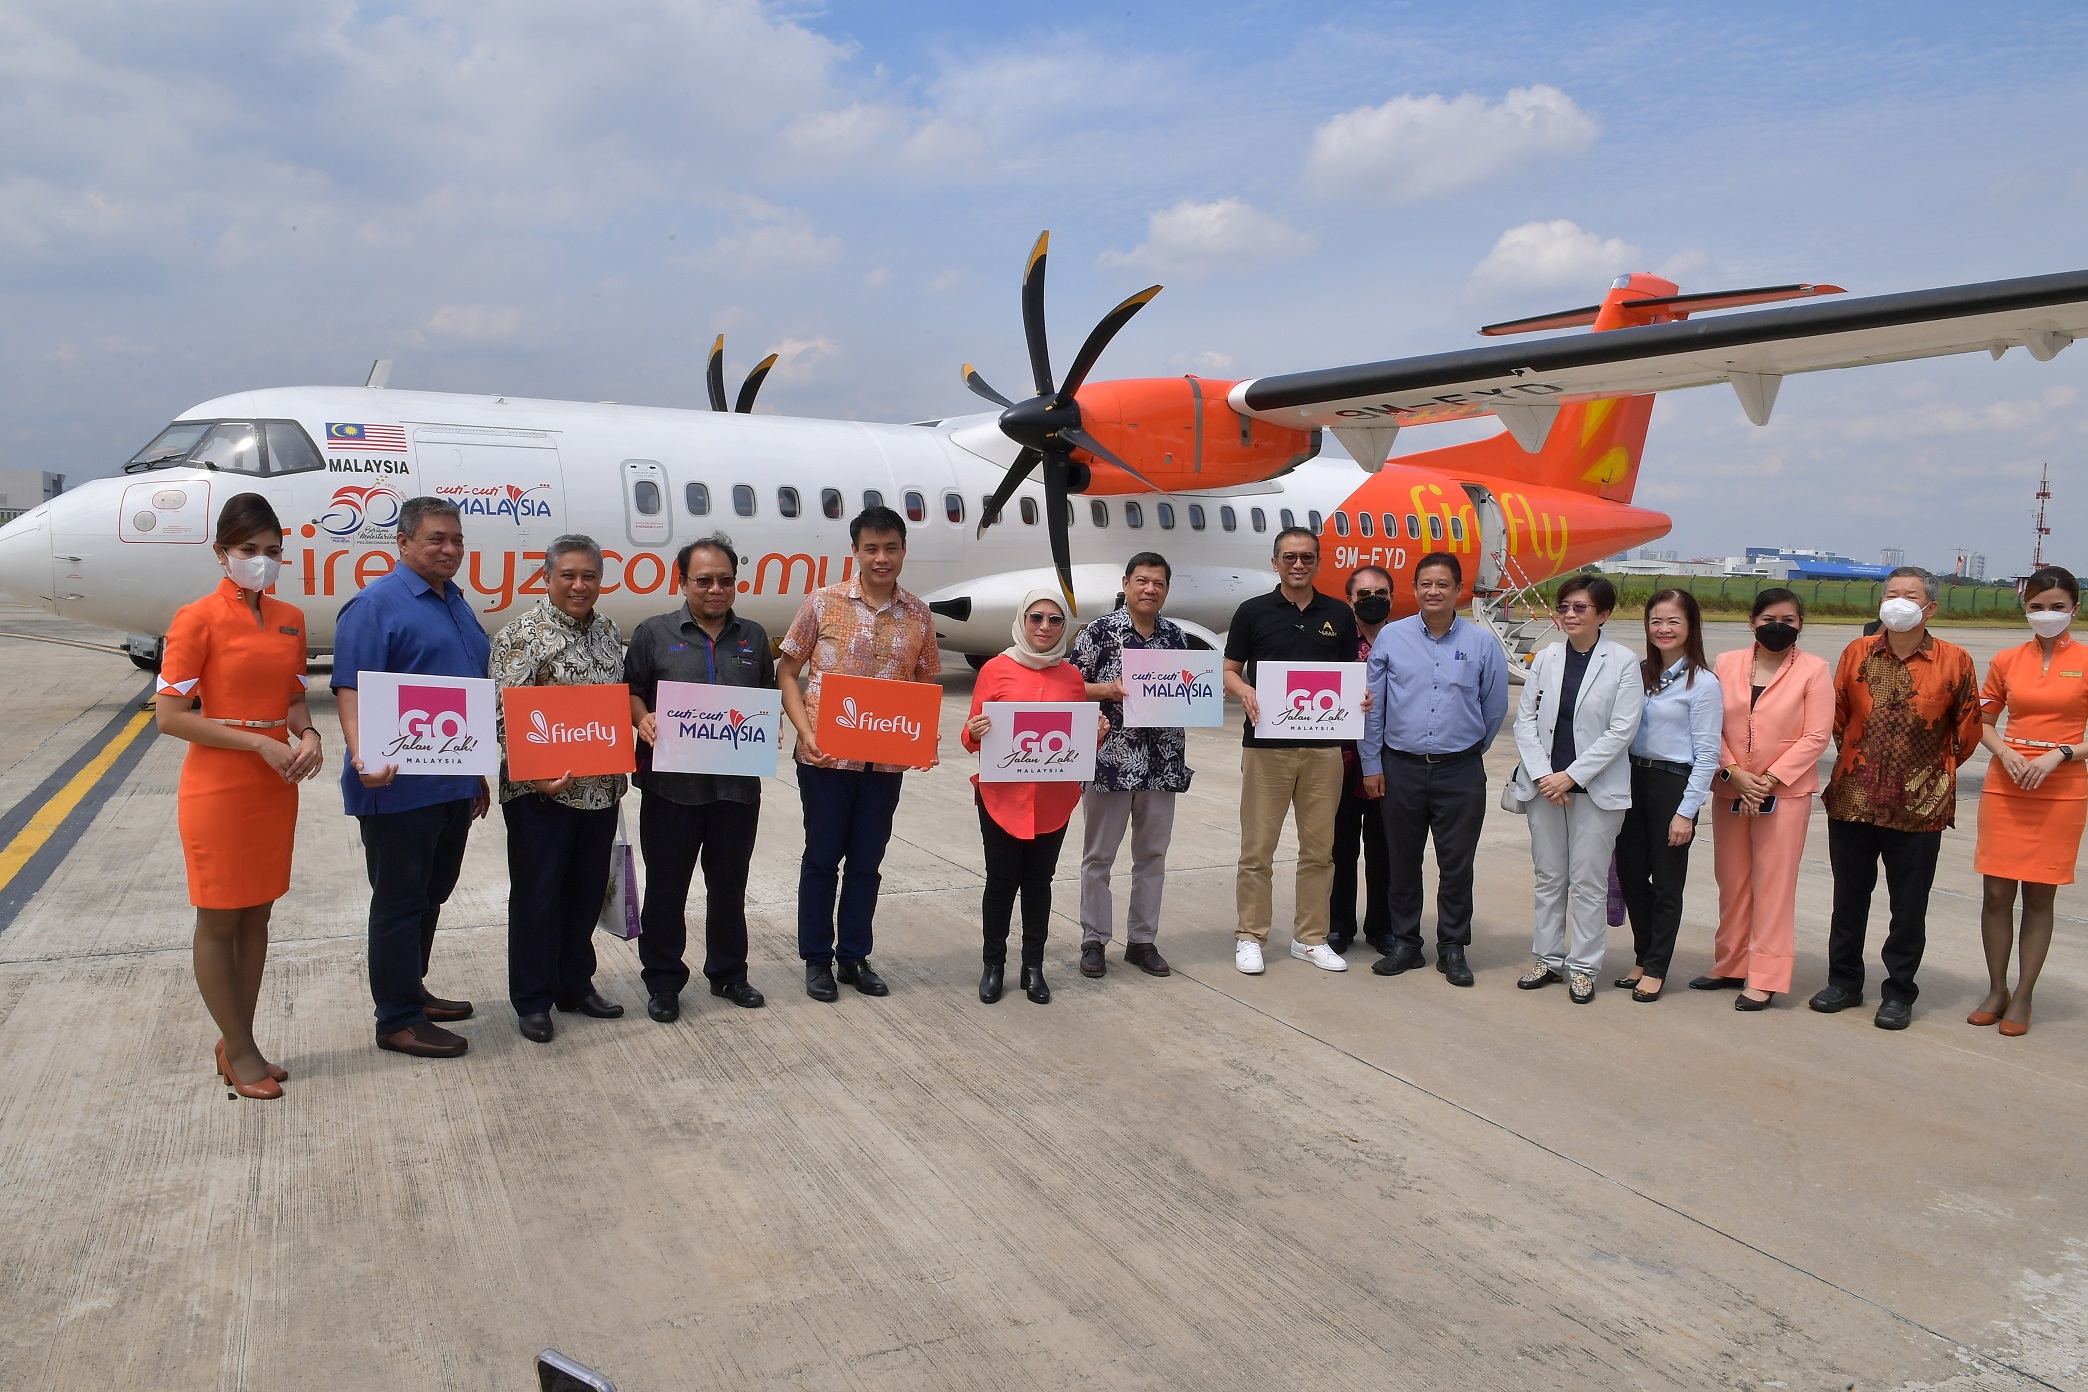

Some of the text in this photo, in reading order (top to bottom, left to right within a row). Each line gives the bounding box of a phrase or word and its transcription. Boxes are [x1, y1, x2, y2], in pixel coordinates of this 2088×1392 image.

[328, 458, 410, 475] MALAYSIA
[435, 484, 504, 497] cuti-cuti
[447, 497, 552, 526] MALAYSIA
[1410, 483, 1568, 582] firfly
[1334, 546, 1406, 570] 9M-FYD
[1131, 671, 1181, 681] cuti-cuti
[1142, 683, 1213, 706] MALAYSIA
[1286, 688, 1341, 711] GO
[399, 709, 468, 739] GO
[667, 708, 728, 721] cuti-cuti
[859, 711, 921, 741] firefly
[1271, 708, 1349, 726] Jalan Lah!
[381, 734, 479, 757] Jalan Lah!
[551, 721, 616, 747] firefly
[679, 721, 766, 750] MALAYSIA
[1012, 730, 1071, 754] GO
[996, 750, 1080, 769] Jalan Lah!
